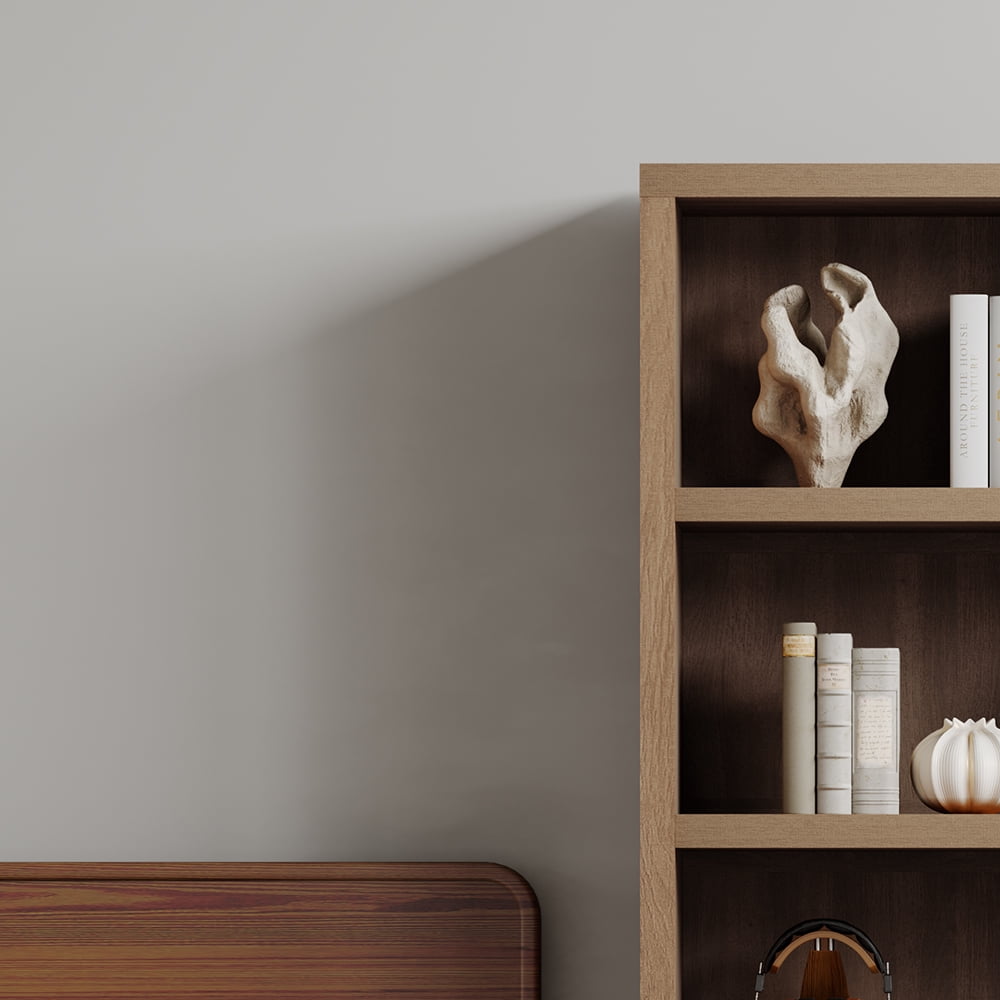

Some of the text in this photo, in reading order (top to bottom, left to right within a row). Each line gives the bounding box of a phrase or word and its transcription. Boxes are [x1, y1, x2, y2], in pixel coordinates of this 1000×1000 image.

[959, 322, 969, 458] AROUND THE HOUSE
[970, 354, 979, 428] FURNITURE
